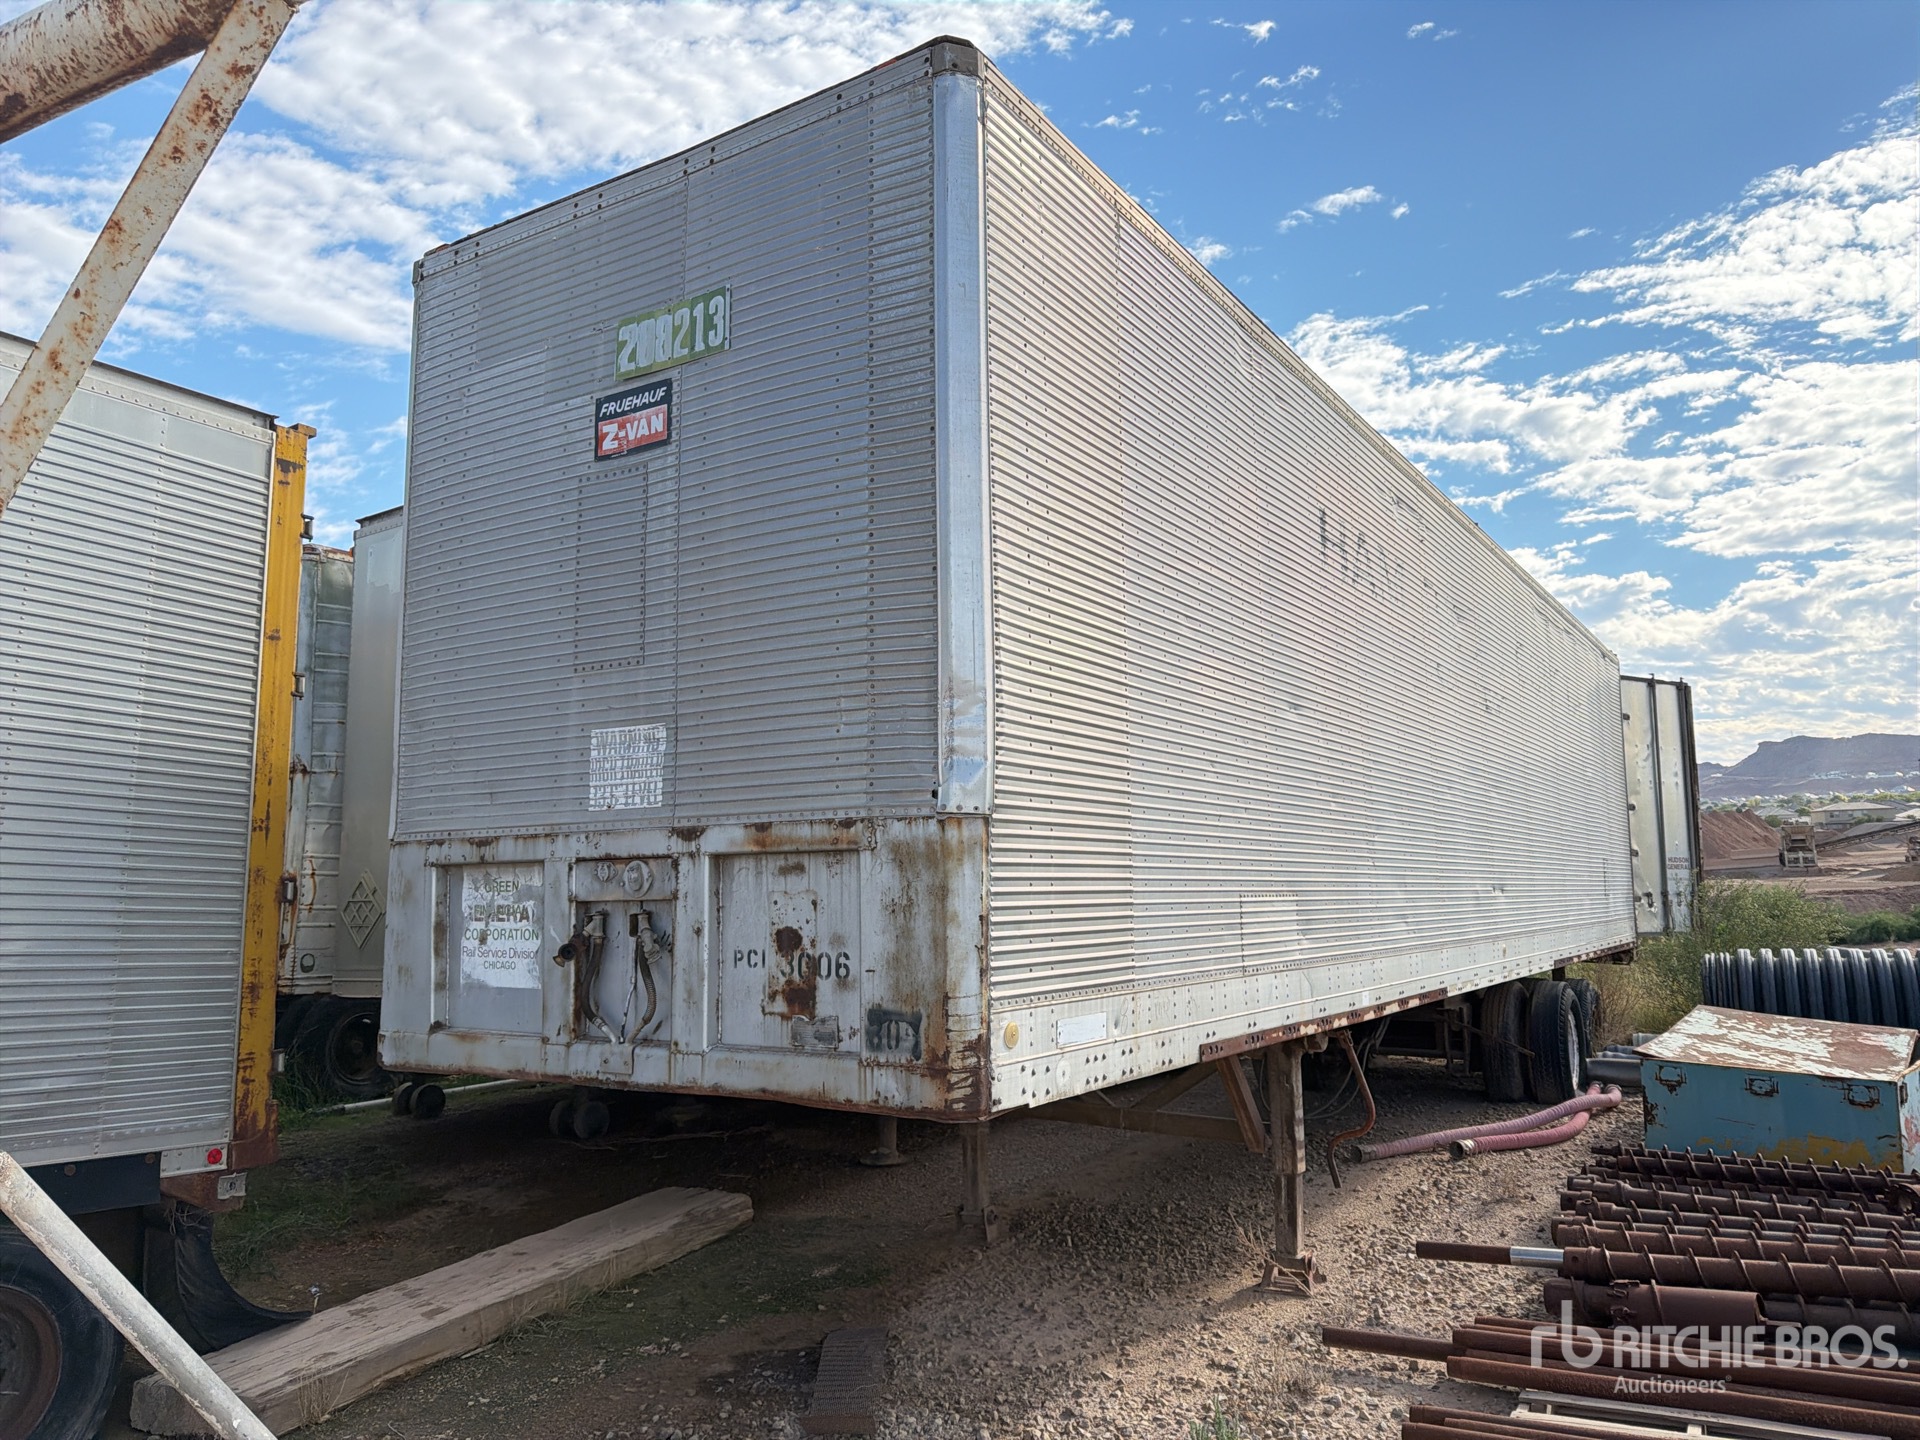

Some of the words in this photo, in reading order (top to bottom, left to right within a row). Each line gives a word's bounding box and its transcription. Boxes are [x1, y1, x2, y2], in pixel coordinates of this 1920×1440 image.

[599, 387, 667, 417] FRUEHAUF
[602, 413, 664, 451] Z-VAN
[462, 946, 475, 957] Rail
[477, 947, 507, 958] Service
[483, 960, 516, 970] CHICAGO
